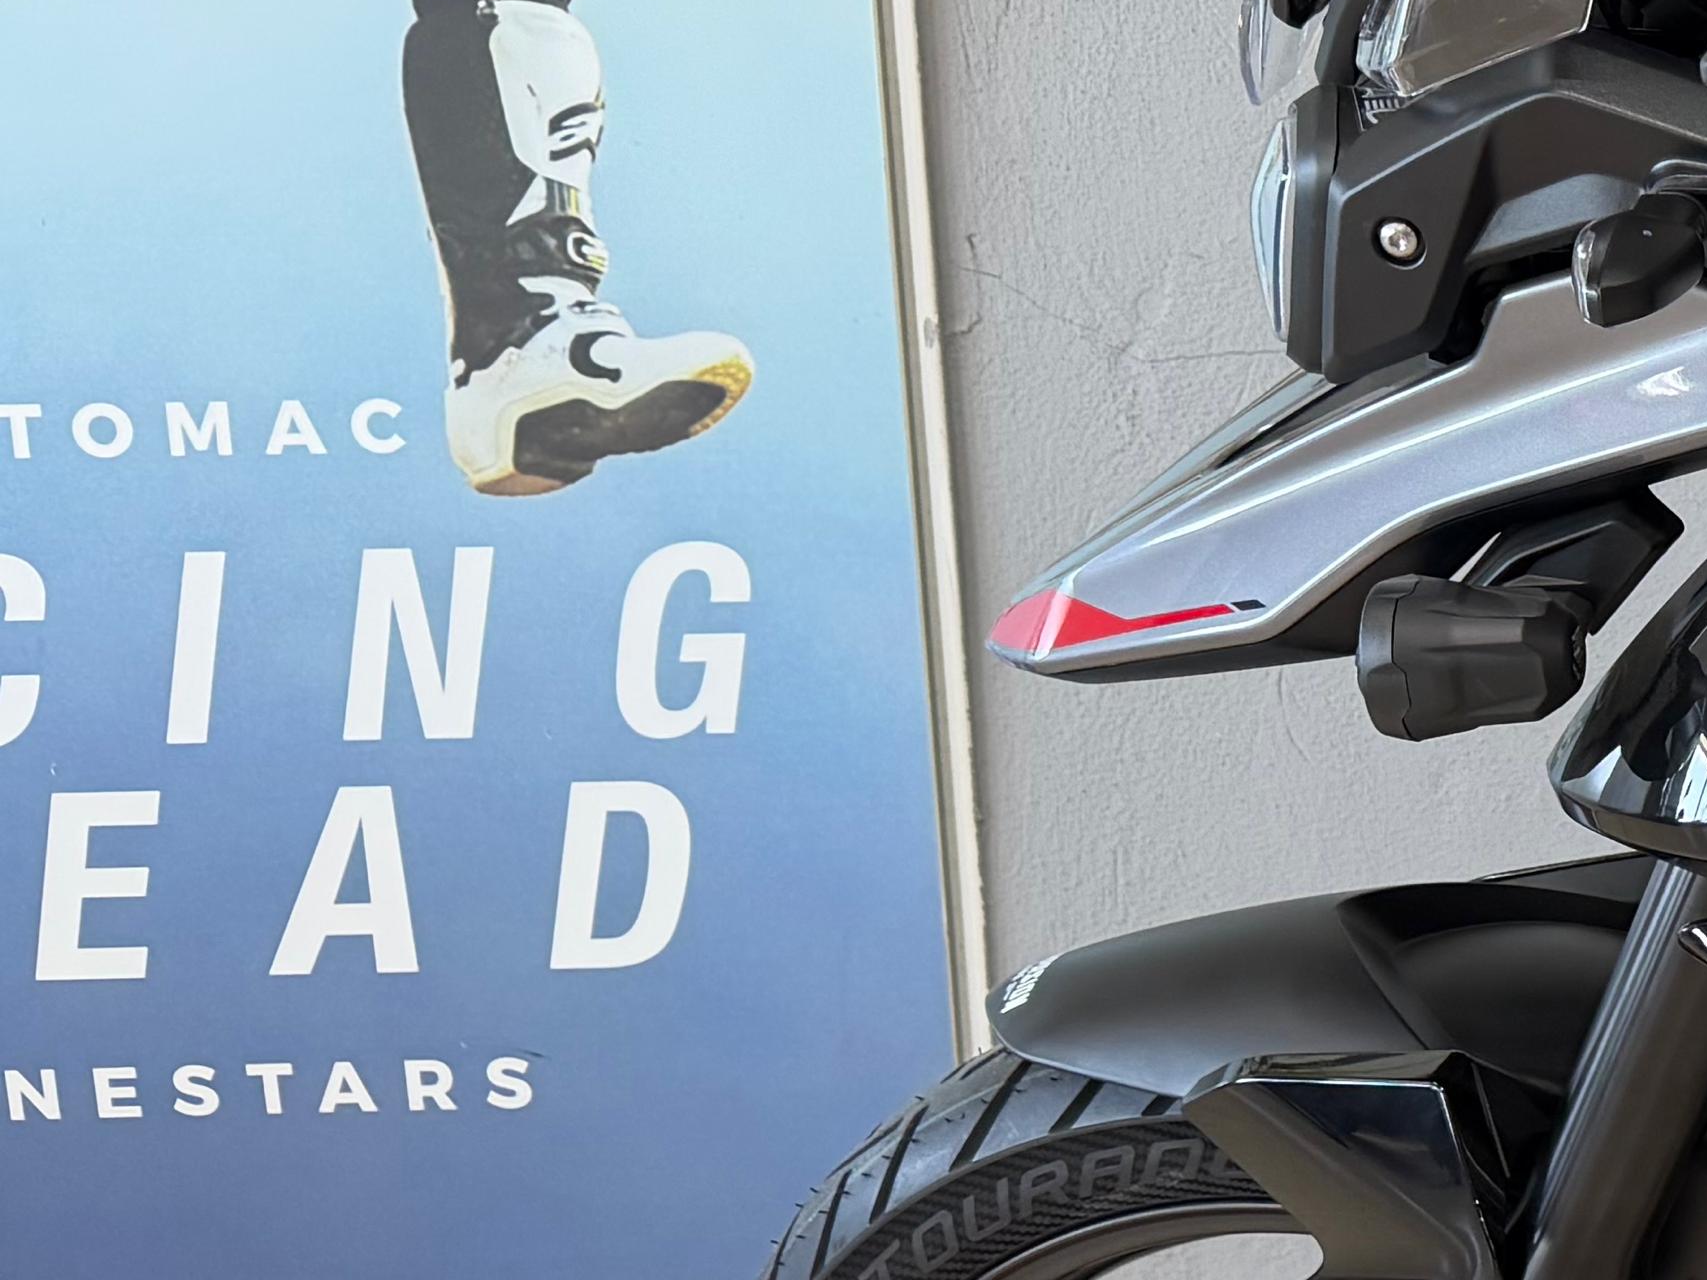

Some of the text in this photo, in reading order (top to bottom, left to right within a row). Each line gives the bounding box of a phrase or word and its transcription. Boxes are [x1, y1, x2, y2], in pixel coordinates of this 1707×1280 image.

[0, 399, 408, 460] TOMAC
[34, 780, 692, 982] EAD
[5, 1055, 536, 1122] NESTARS
